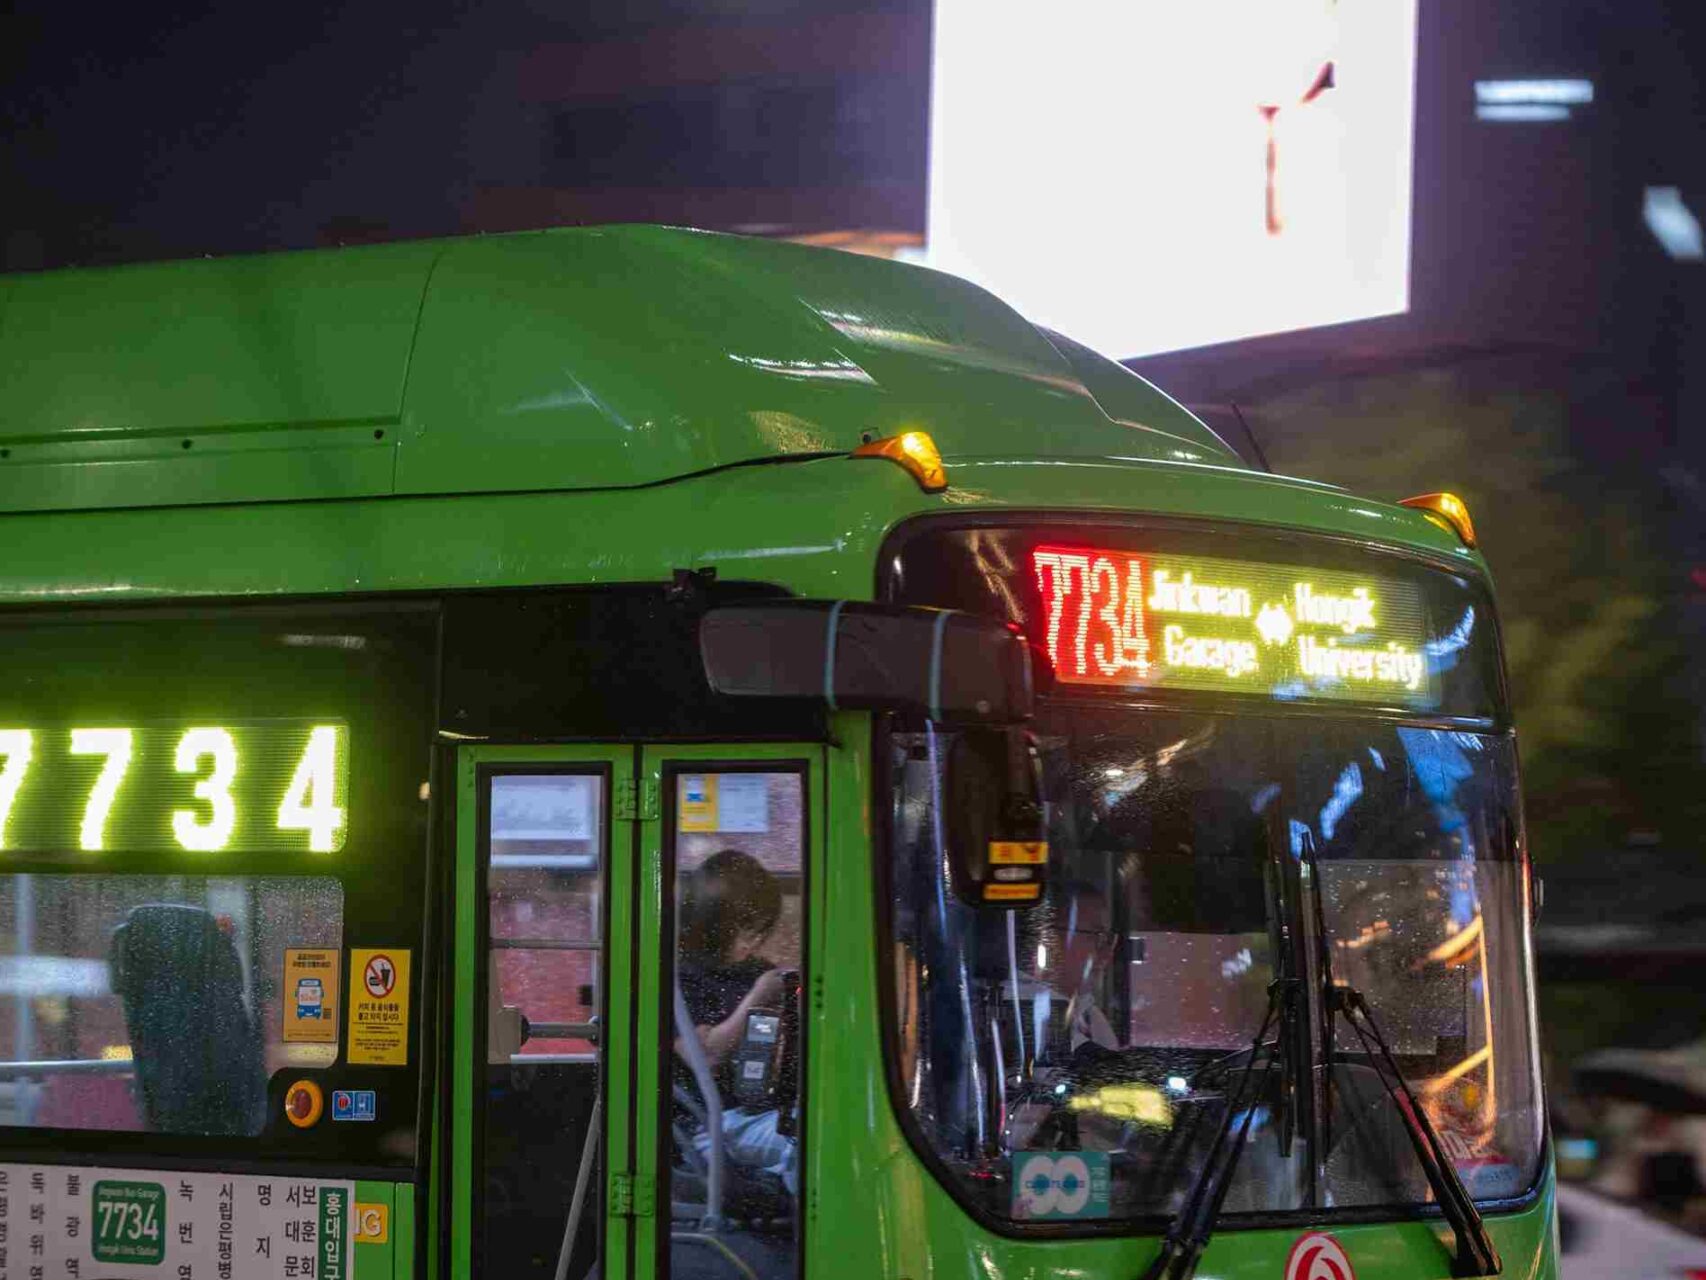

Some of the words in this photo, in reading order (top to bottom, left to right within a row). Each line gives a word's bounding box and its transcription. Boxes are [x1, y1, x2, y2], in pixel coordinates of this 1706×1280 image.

[1033, 551, 1151, 679] 7734
[1163, 625, 1258, 677] Garage
[1298, 636, 1426, 690] University
[98, 1201, 159, 1241] 7734
